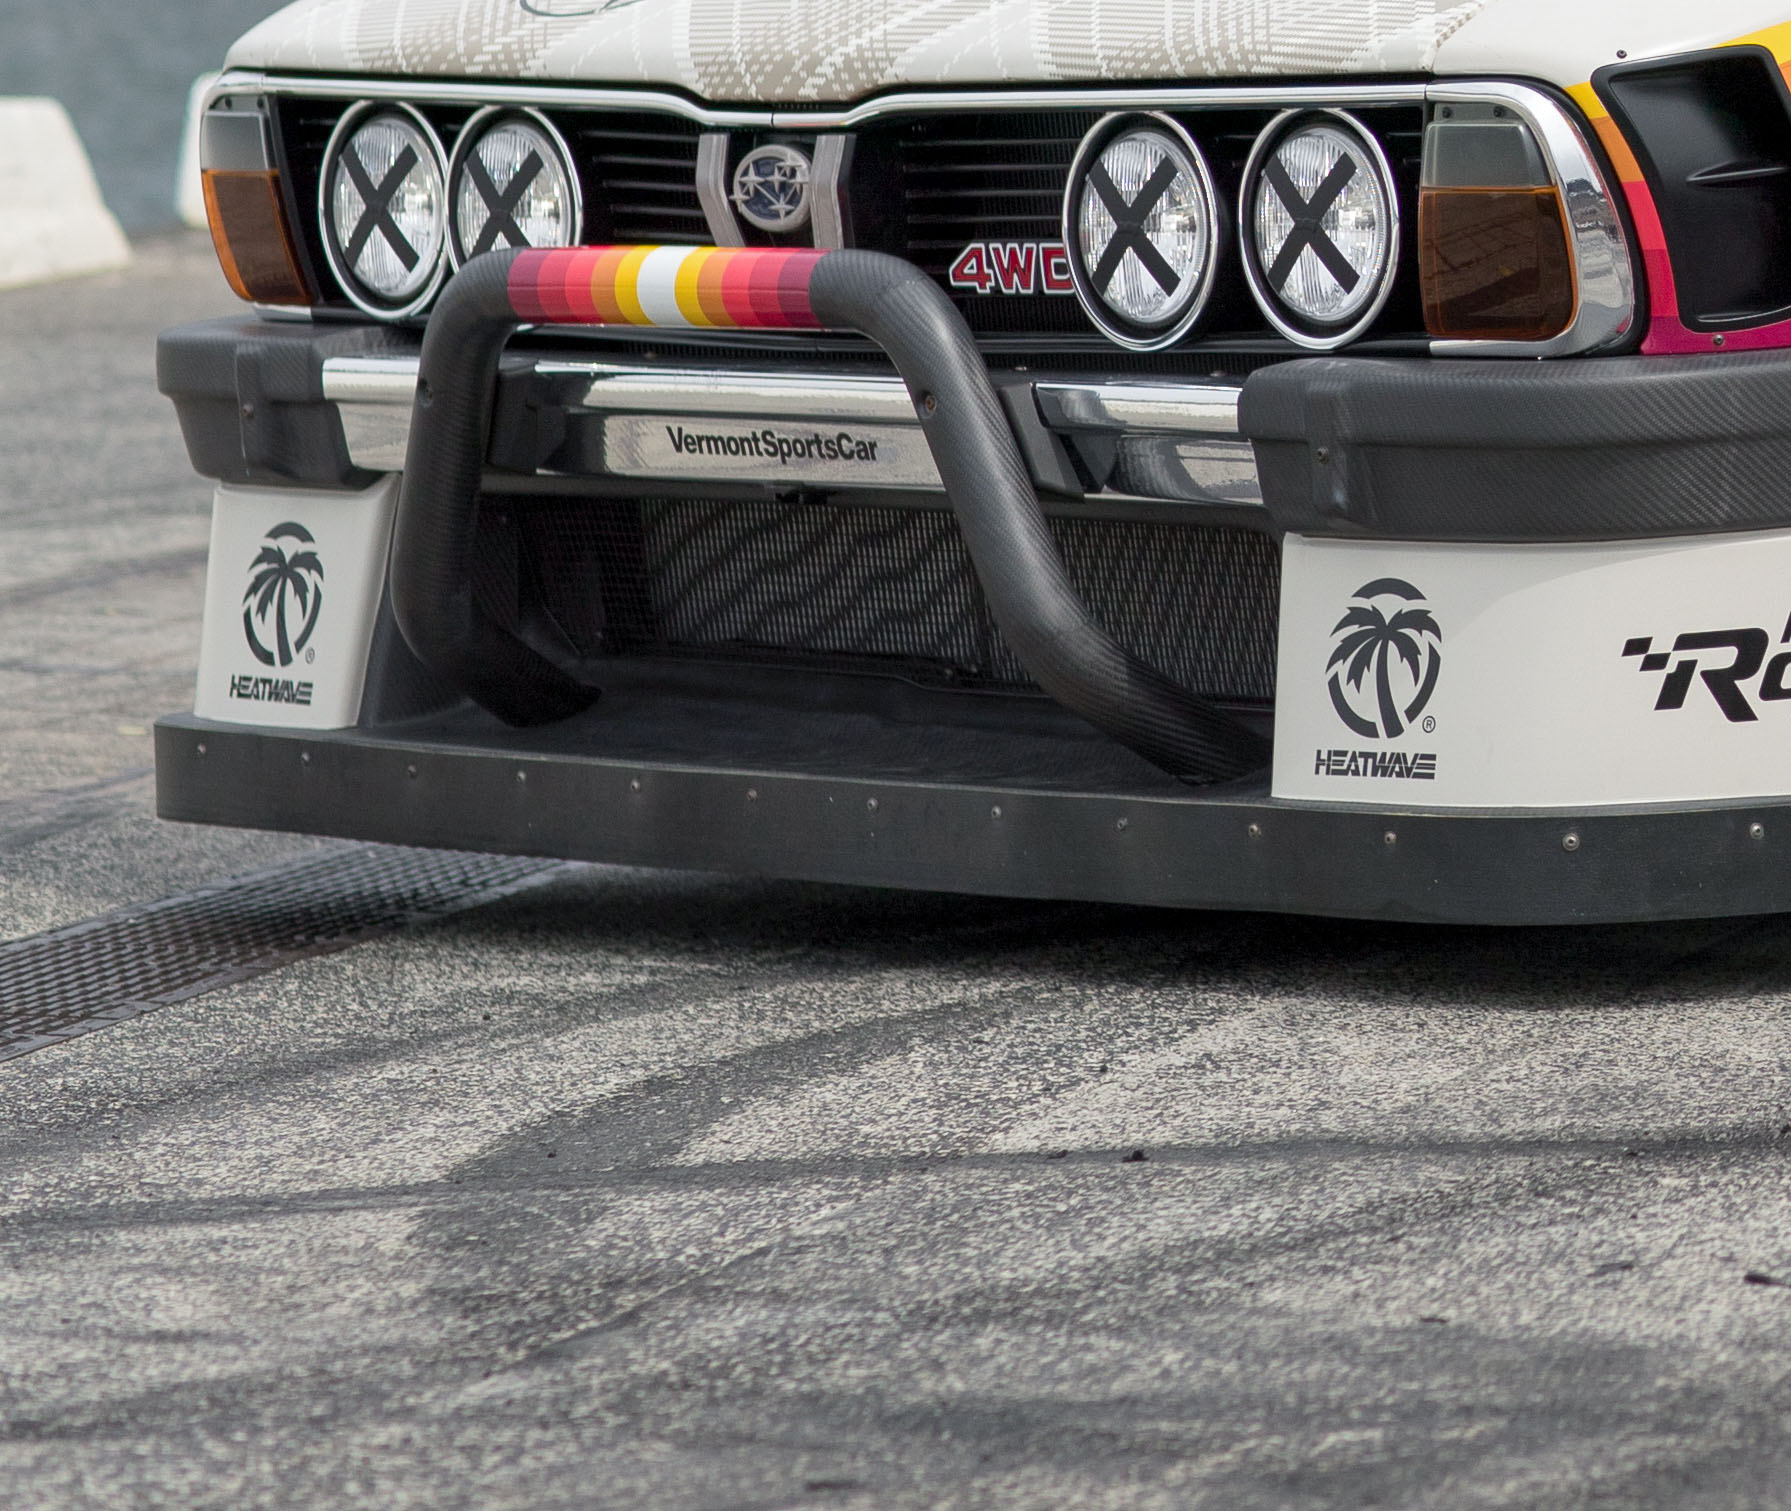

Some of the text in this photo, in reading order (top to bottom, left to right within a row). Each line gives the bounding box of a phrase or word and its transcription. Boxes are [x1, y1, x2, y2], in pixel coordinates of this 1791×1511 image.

[665, 424, 879, 465] VermontSportsCar
[228, 673, 315, 707] HEATWAVE
[1313, 748, 1438, 781] HEATWAVE
